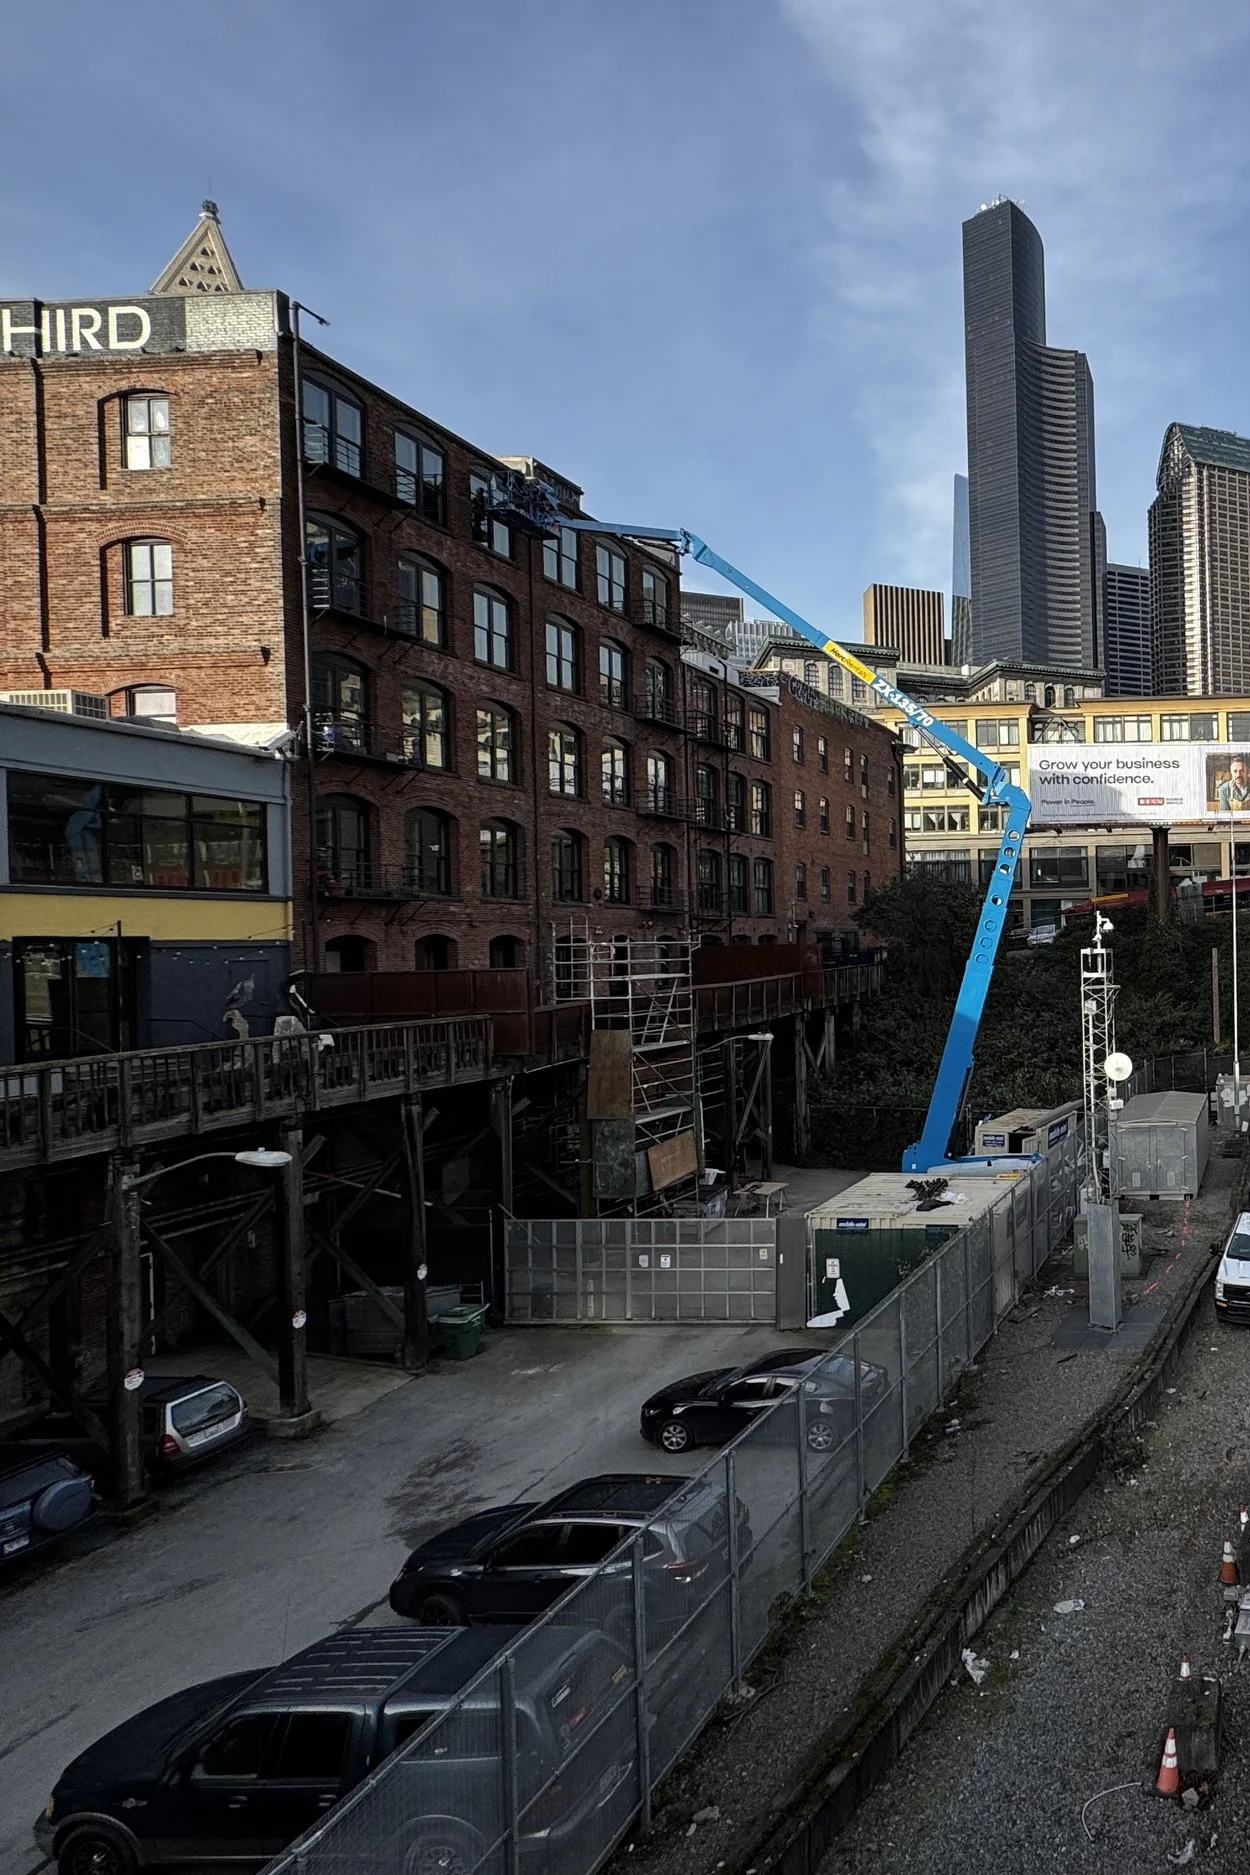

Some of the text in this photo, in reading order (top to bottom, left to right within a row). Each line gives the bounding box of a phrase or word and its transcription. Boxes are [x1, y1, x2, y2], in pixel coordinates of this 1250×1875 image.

[1039, 757, 1180, 772] Grow your business
[1039, 773, 1154, 785] with confidence.
